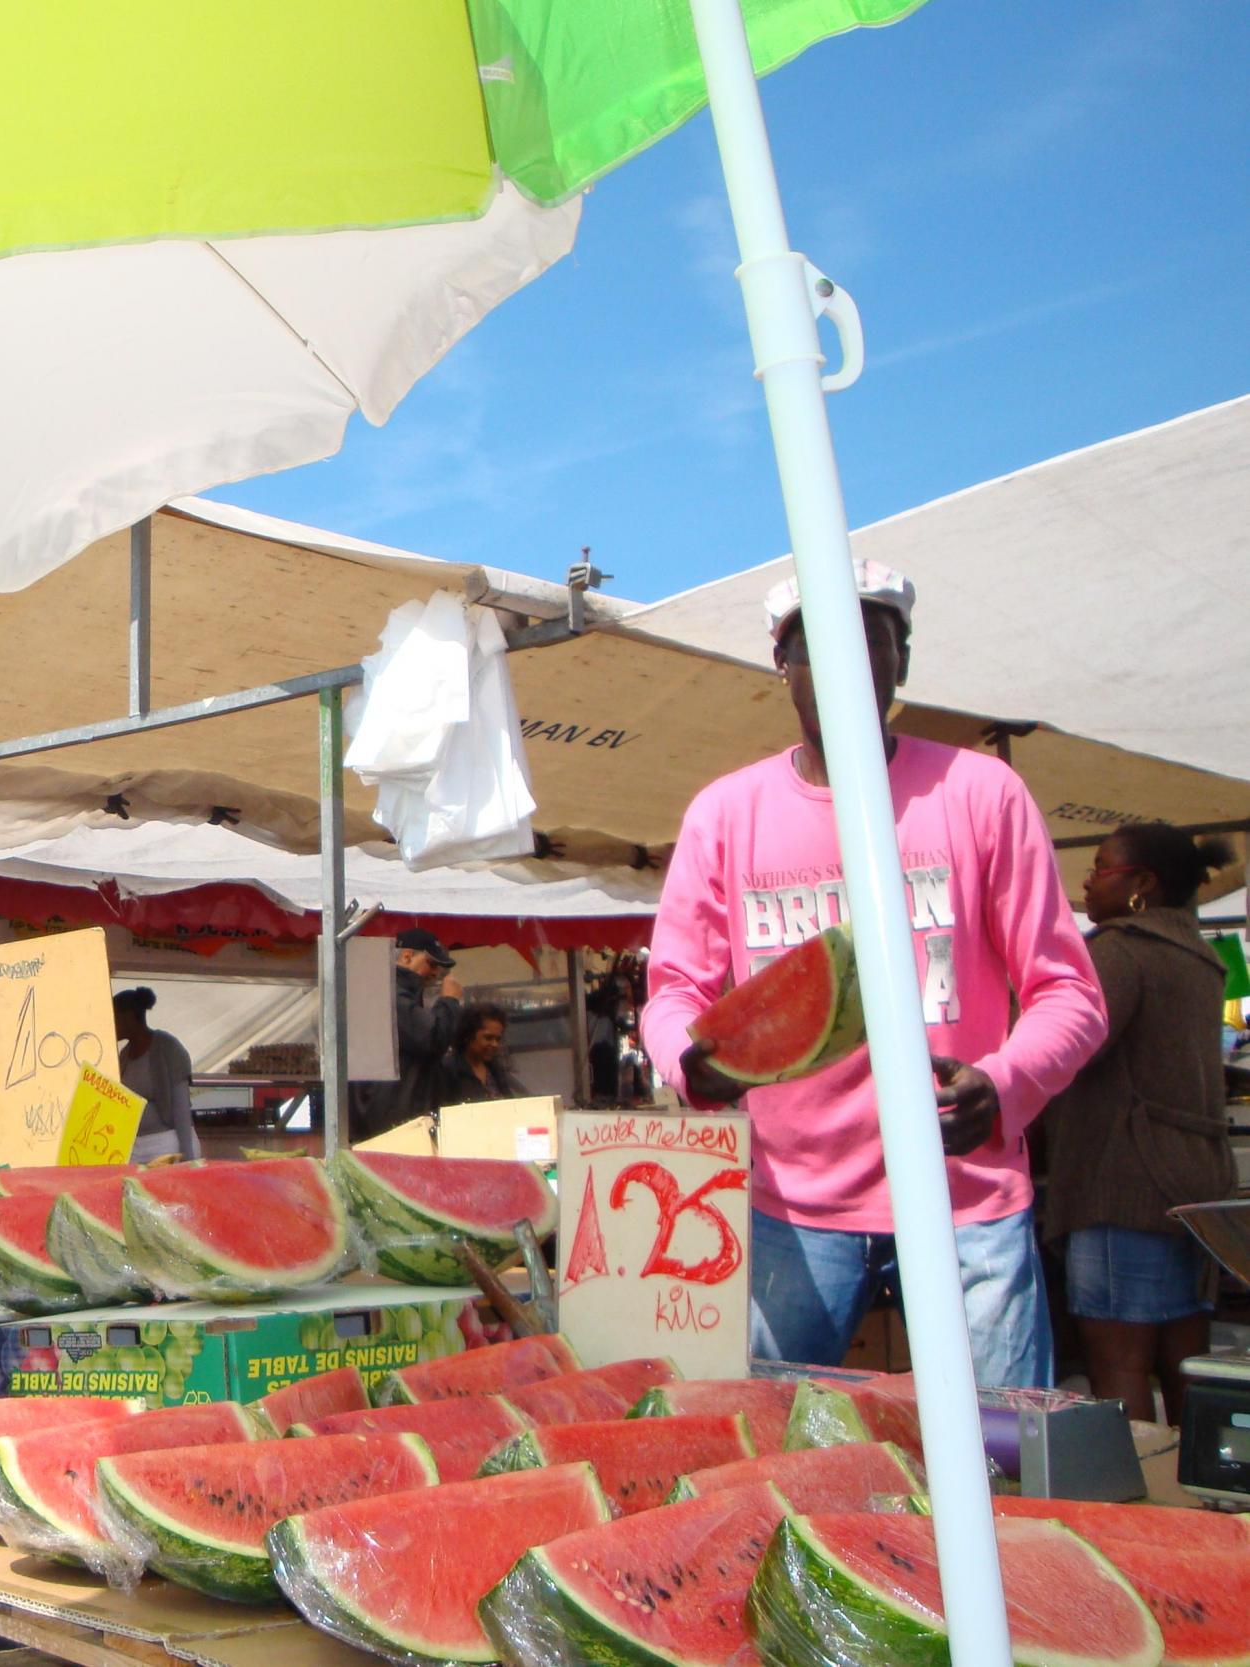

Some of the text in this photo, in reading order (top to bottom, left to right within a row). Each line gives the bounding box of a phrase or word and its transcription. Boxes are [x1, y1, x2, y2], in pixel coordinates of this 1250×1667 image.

[586, 729, 642, 749] BV
[742, 865, 822, 889] NOTHING'S
[742, 865, 955, 949] BRON
[248, 1343, 417, 1378] RAISINS DE TABLE
[12, 1372, 158, 1392] RAISINS DE TABLE
